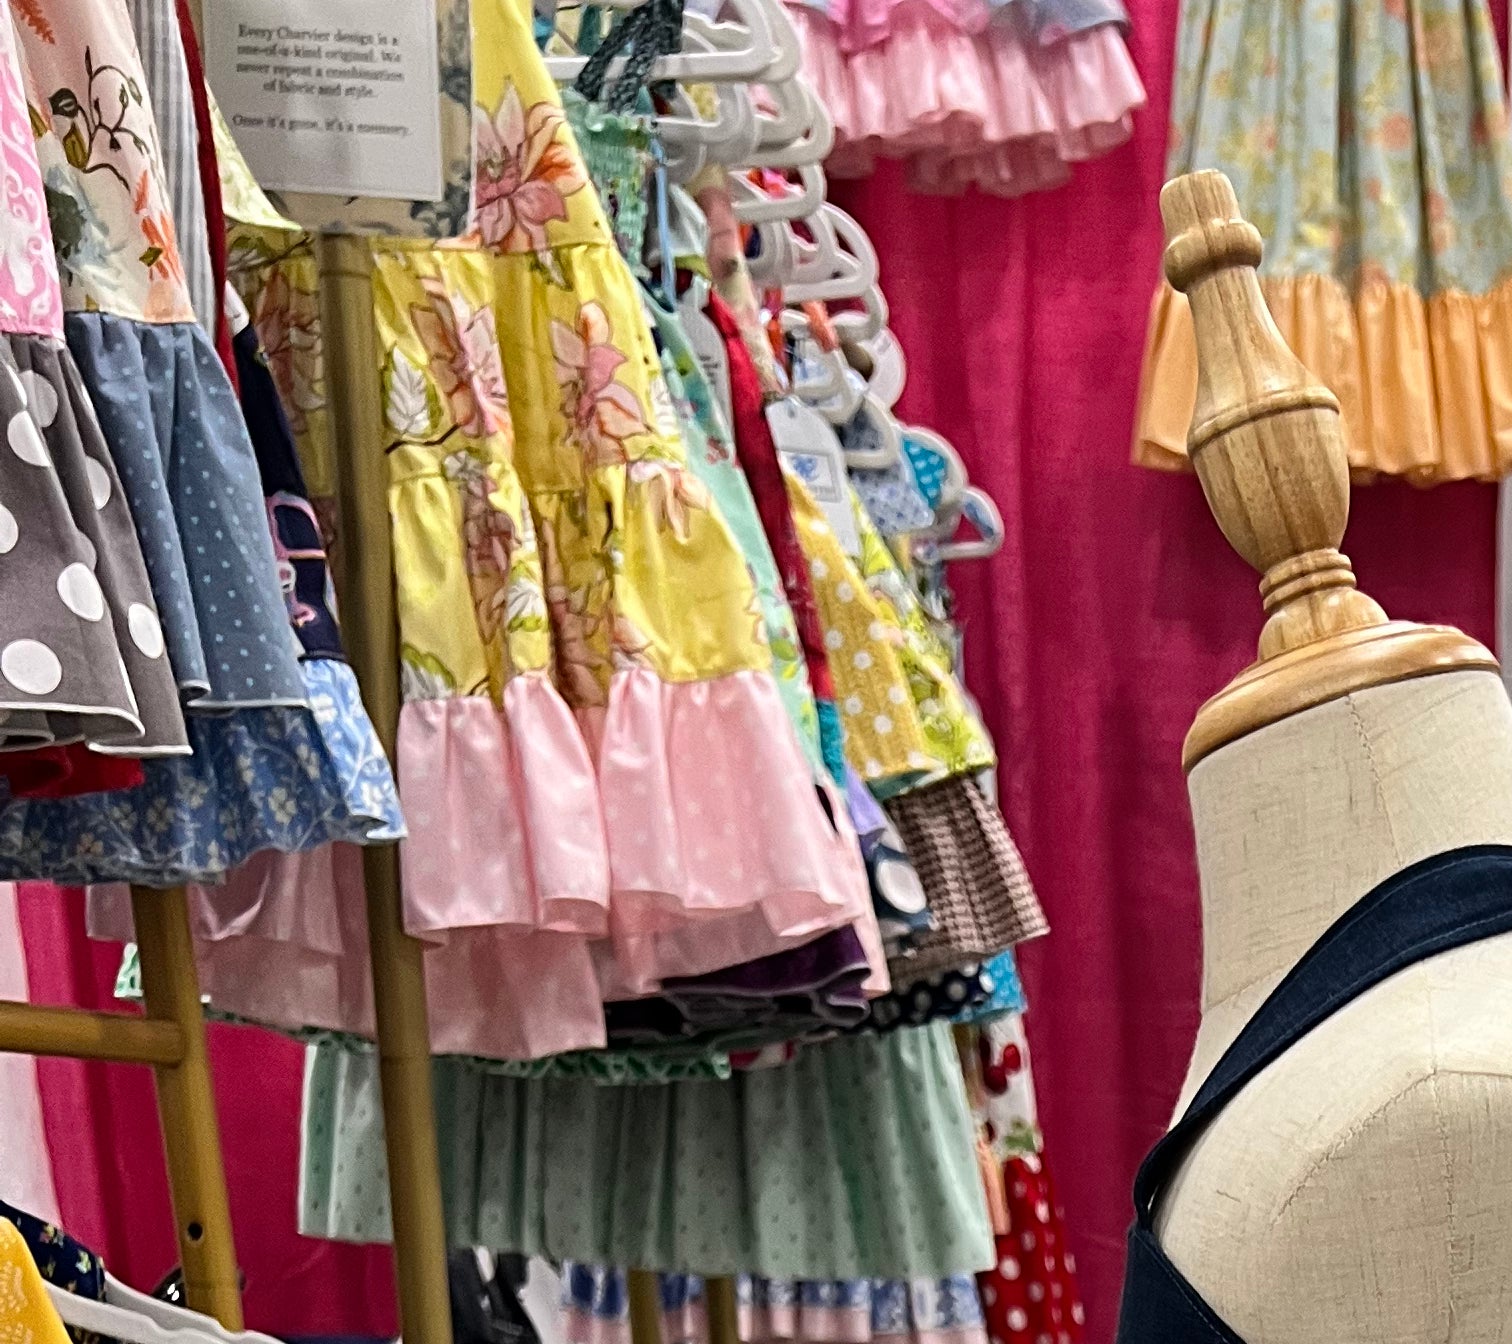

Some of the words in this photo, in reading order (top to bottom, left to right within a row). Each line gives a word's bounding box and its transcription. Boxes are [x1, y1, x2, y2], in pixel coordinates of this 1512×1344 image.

[238, 23, 272, 41] Every
[276, 26, 331, 42] Charvier
[333, 28, 374, 46] design
[381, 49, 402, 63] We
[236, 63, 271, 74] never
[272, 65, 313, 78] repeat
[325, 66, 405, 82] combination
[263, 78, 277, 92] of
[278, 79, 317, 95] fabric
[317, 82, 342, 97] and
